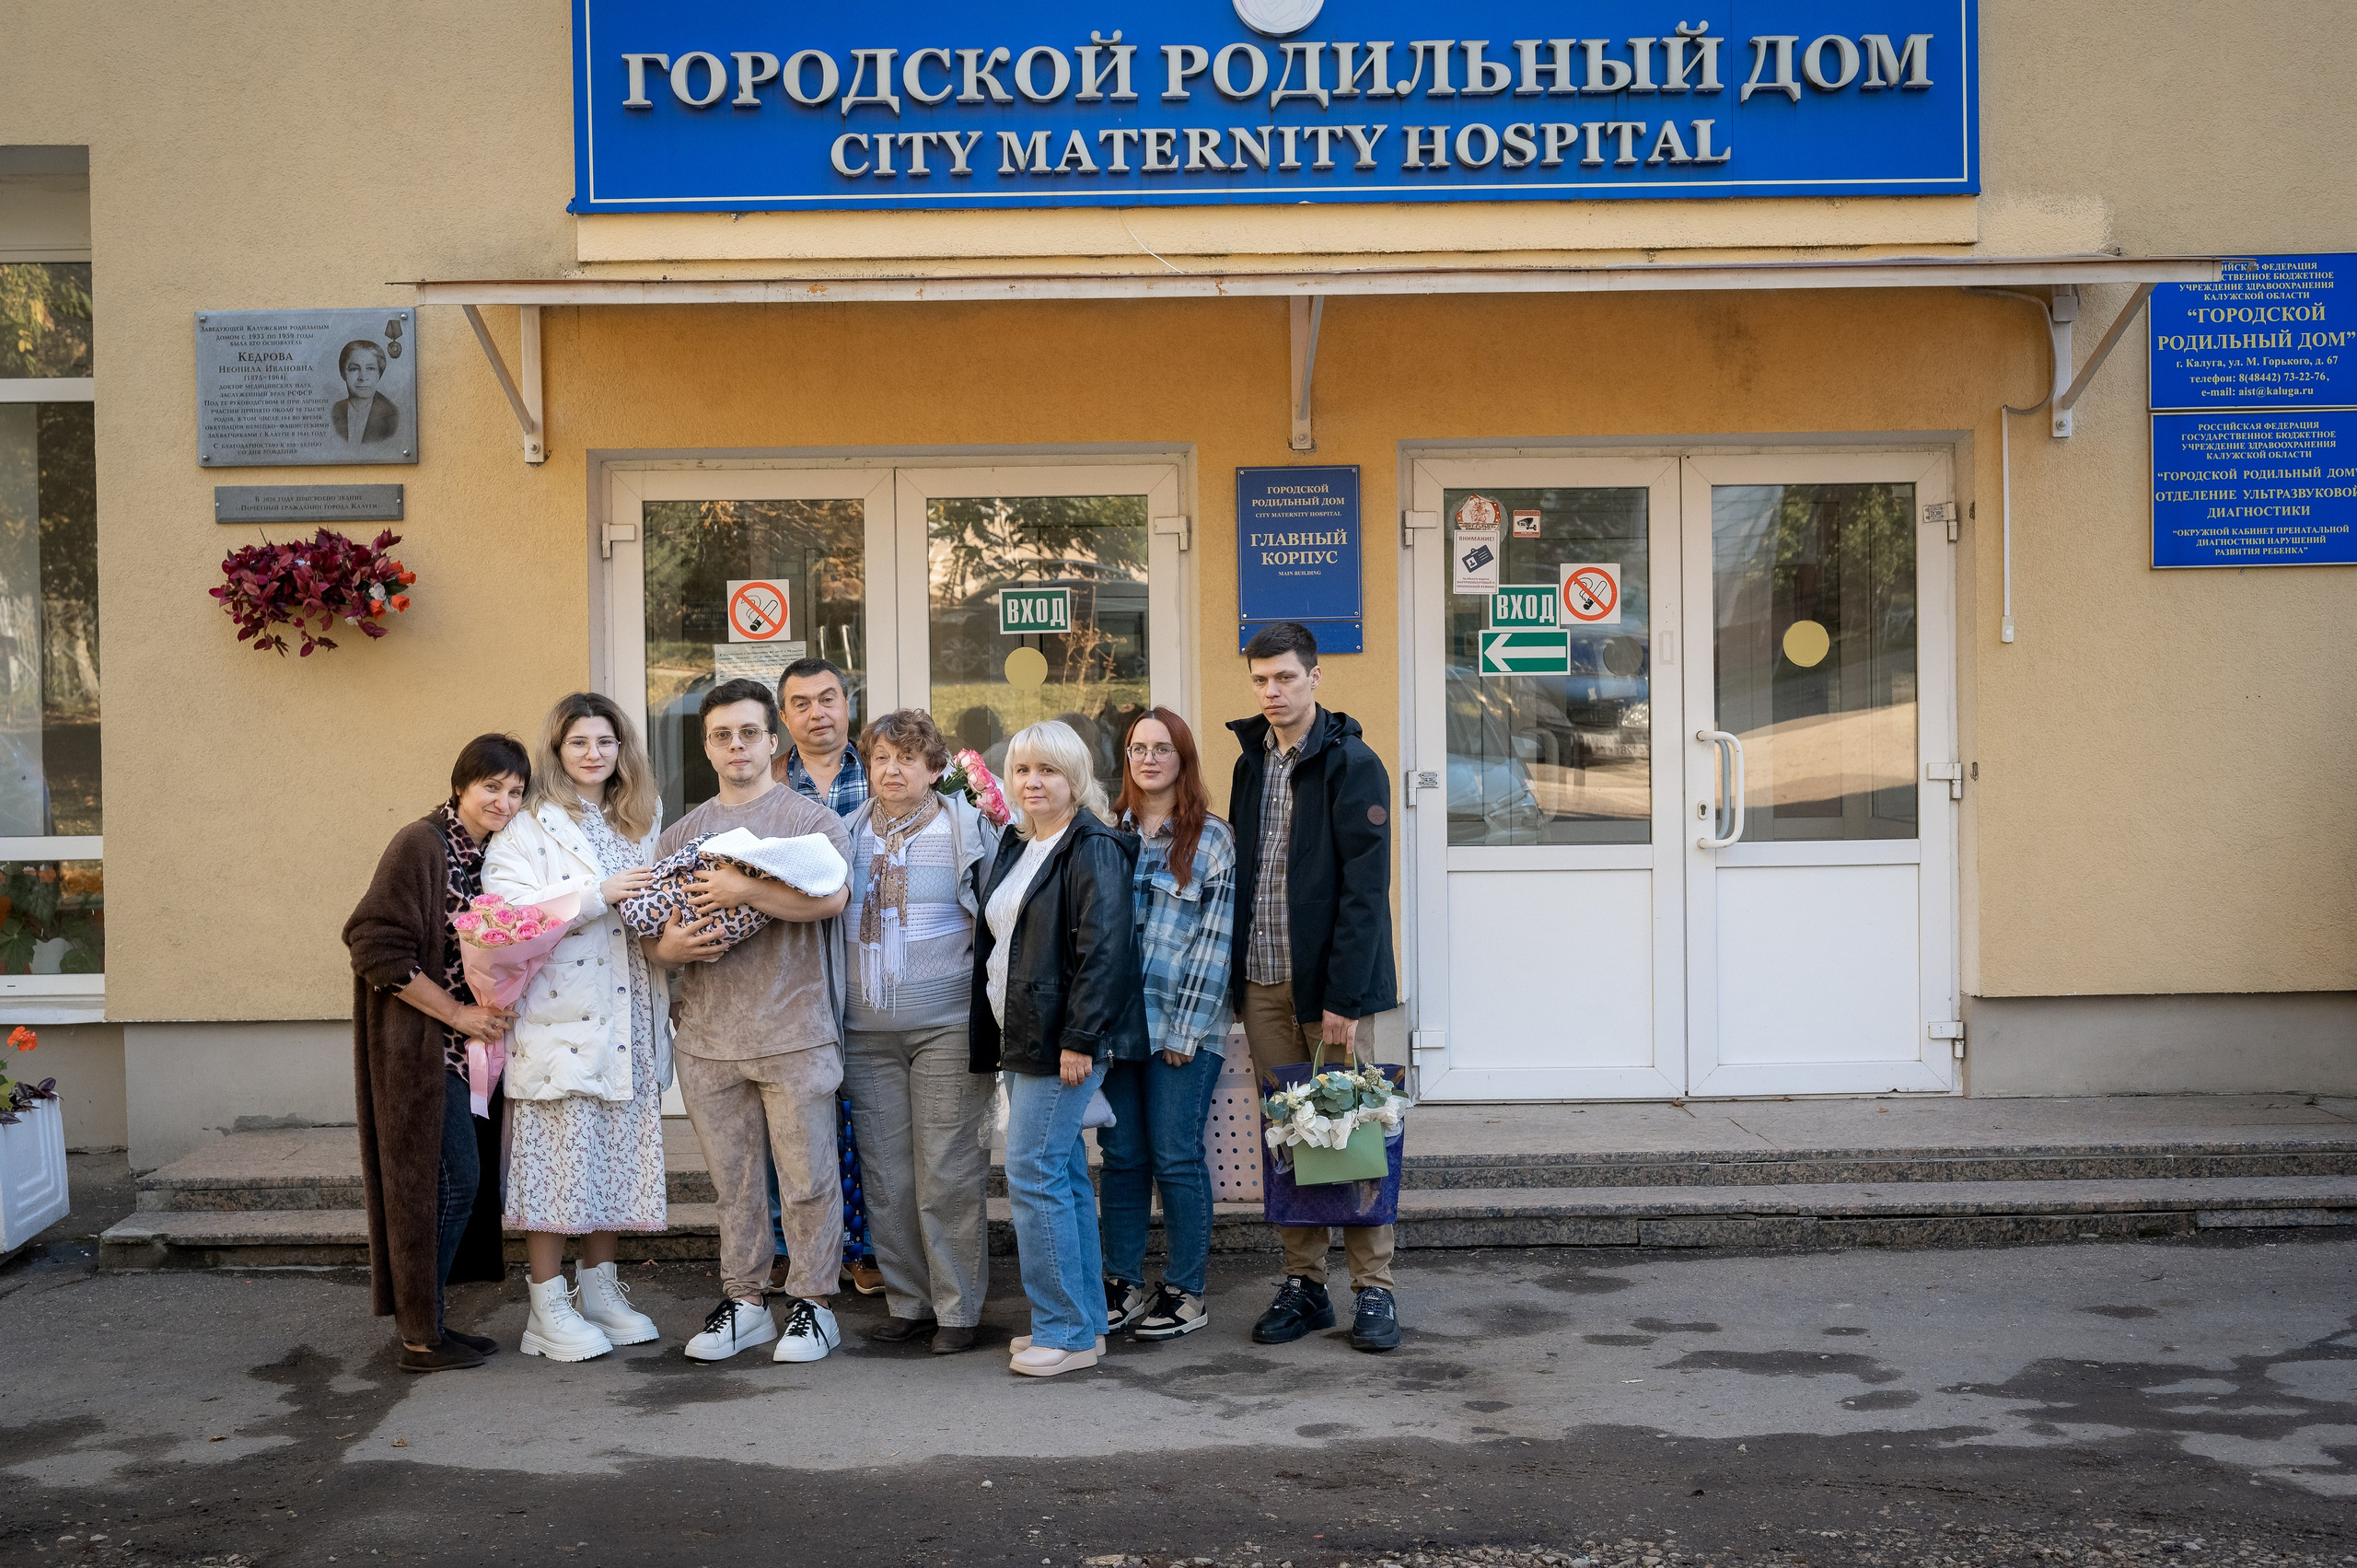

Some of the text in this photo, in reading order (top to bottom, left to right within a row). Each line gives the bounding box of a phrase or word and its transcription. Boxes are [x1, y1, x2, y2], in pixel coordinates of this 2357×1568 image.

[621, 20, 1933, 117] ГОРОДСКОЙ РОДИЛЬНЫЙ ДОМ
[830, 119, 1732, 177] CITY MATERNITY HOSPITAL
[2262, 262, 2317, 271] ФЕДЕРАЦИЯ
[2273, 272, 2334, 280] БЮДЖЕТНОЕ
[2179, 282, 2334, 292] УЧРЕЖДЕНИЕ ЗДРАВООХРАНЕНИЯ
[2204, 292, 2309, 301] КАЛУЖСКОЙ ОБЛАСТИ
[2158, 330, 2292, 353] РОДИЛЬНЫЙ
[238, 352, 293, 362] КЕДРОВА
[2186, 358, 2226, 369] Калуга,
[2229, 359, 2243, 368] ул.
[2263, 357, 2312, 367] Горького,
[2315, 357, 2323, 366] д.
[2189, 372, 2329, 385] телефон: 8(48442) 73-22-76,
[2239, 387, 2314, 398] aist@kaluga.ru
[2181, 431, 2336, 441] ГОСУДАРСТВЕННОЕ БЮДЖЕТНОЕ
[2182, 440, 2336, 450] УЧРЕЖДЕНИЕ ЗДРАВООХРАНЕНИЯ
[2207, 451, 2266, 459] КАЛУЖСКОЙ
[2244, 468, 2321, 480] РОДИЛЬНЫЙ
[1267, 484, 1329, 494] ГОРОДСКОЙ
[2155, 490, 2236, 502] ОТДЕЛЕНИЕ
[1252, 497, 1344, 507] РОДИЛЬНЫЙ ДОМ
[2207, 506, 2310, 519] ДИАГНОСТИКИ
[2277, 525, 2349, 534] ПРЕНАТАЛЬНОЙ
[1250, 528, 1347, 547] ГЛАВНЫЙ
[2196, 536, 2326, 546] ДИАГНОСТИКИ НАРУШЕНИЙ
[1261, 551, 1338, 564] КОРПУС
[1006, 596, 1065, 627] ВХОД
[1497, 594, 1554, 622] ВХОД
